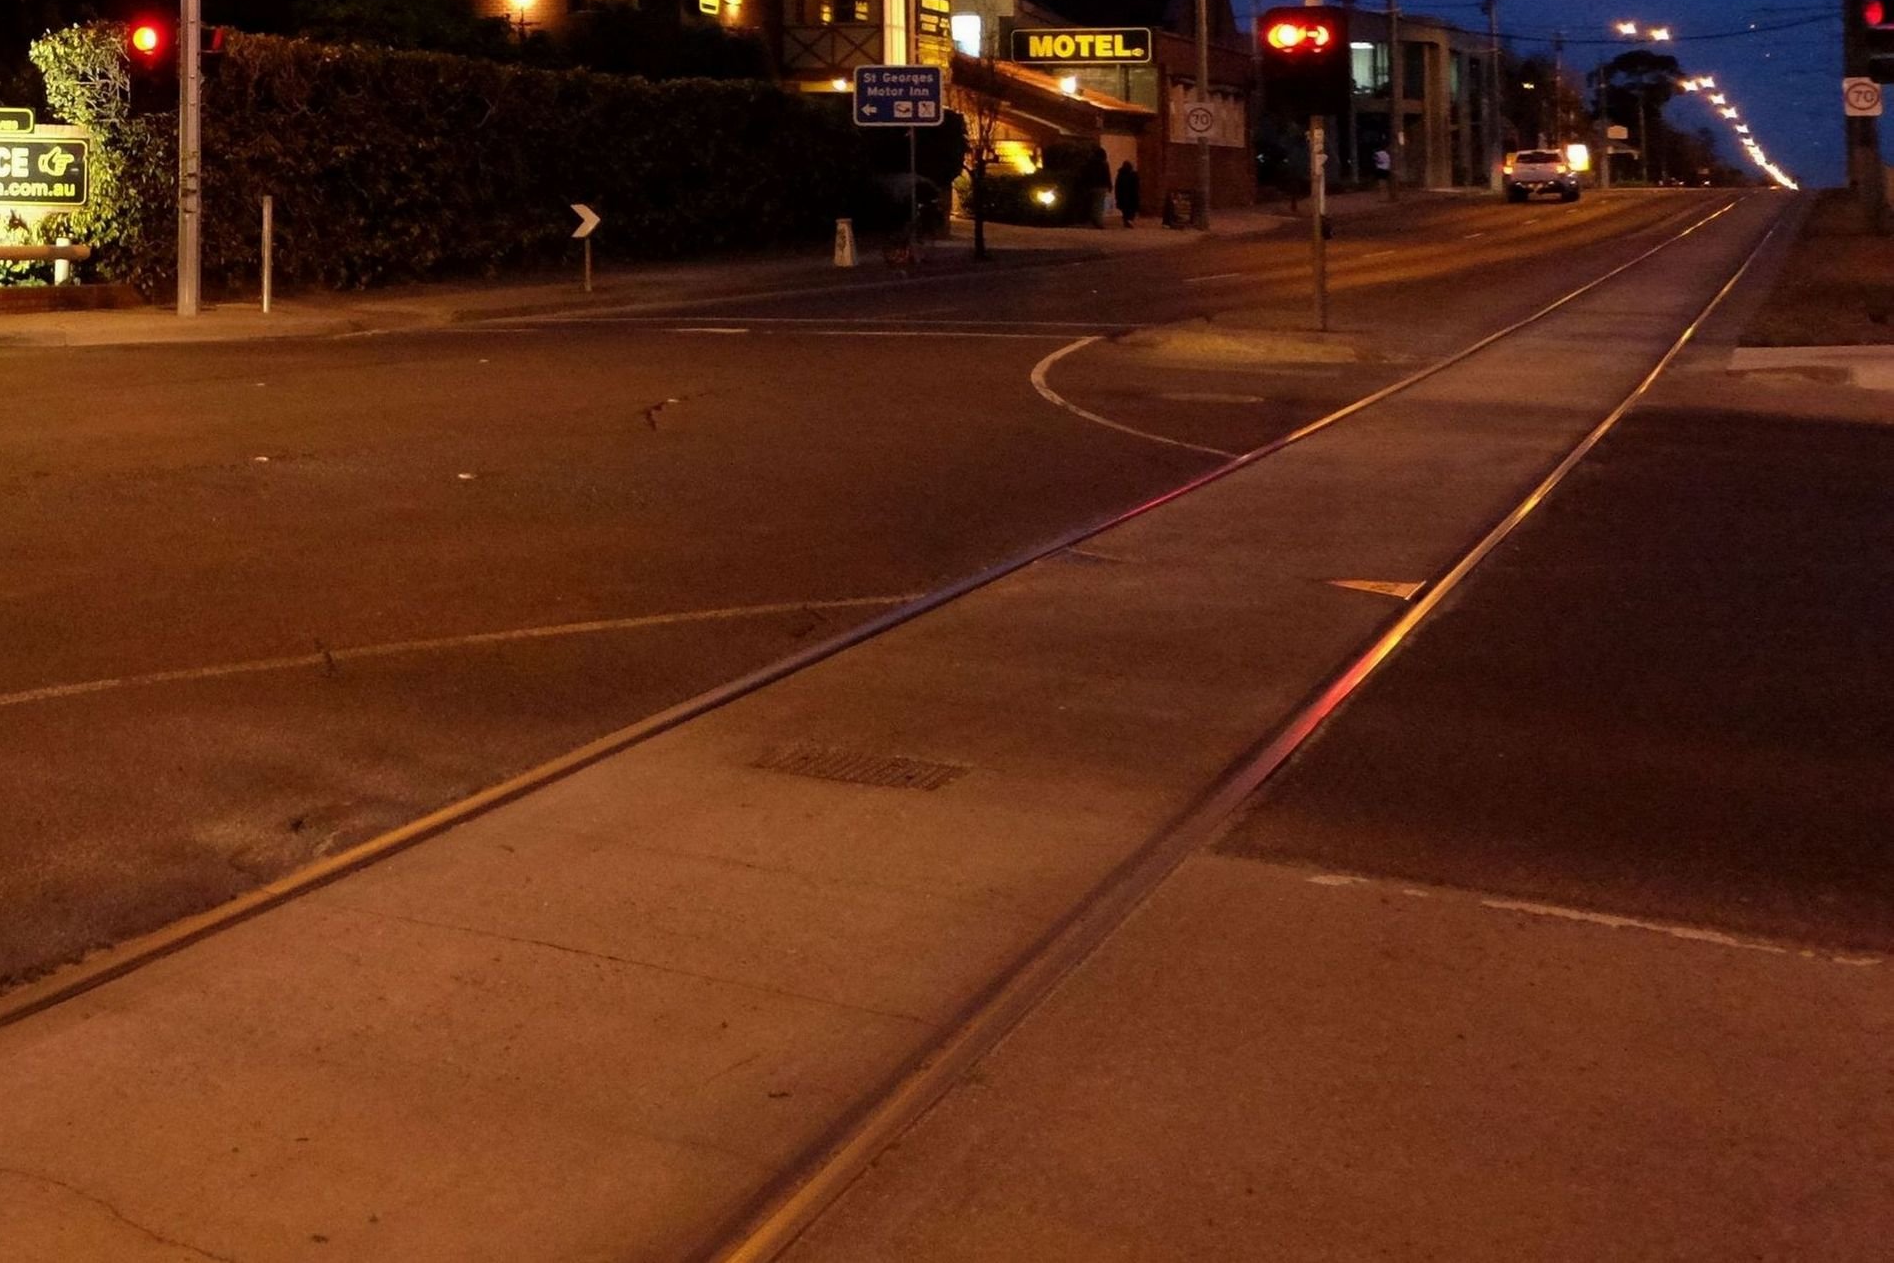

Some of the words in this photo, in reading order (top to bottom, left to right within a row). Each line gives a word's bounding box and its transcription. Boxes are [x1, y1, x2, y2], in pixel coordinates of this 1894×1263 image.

[1029, 35, 1131, 57] MOTEL
[863, 73, 877, 83] St
[882, 73, 934, 85] Georges
[867, 86, 904, 96] Motor
[909, 86, 930, 96] Inn
[1853, 90, 1875, 103] 70
[1192, 113, 1209, 125] 70
